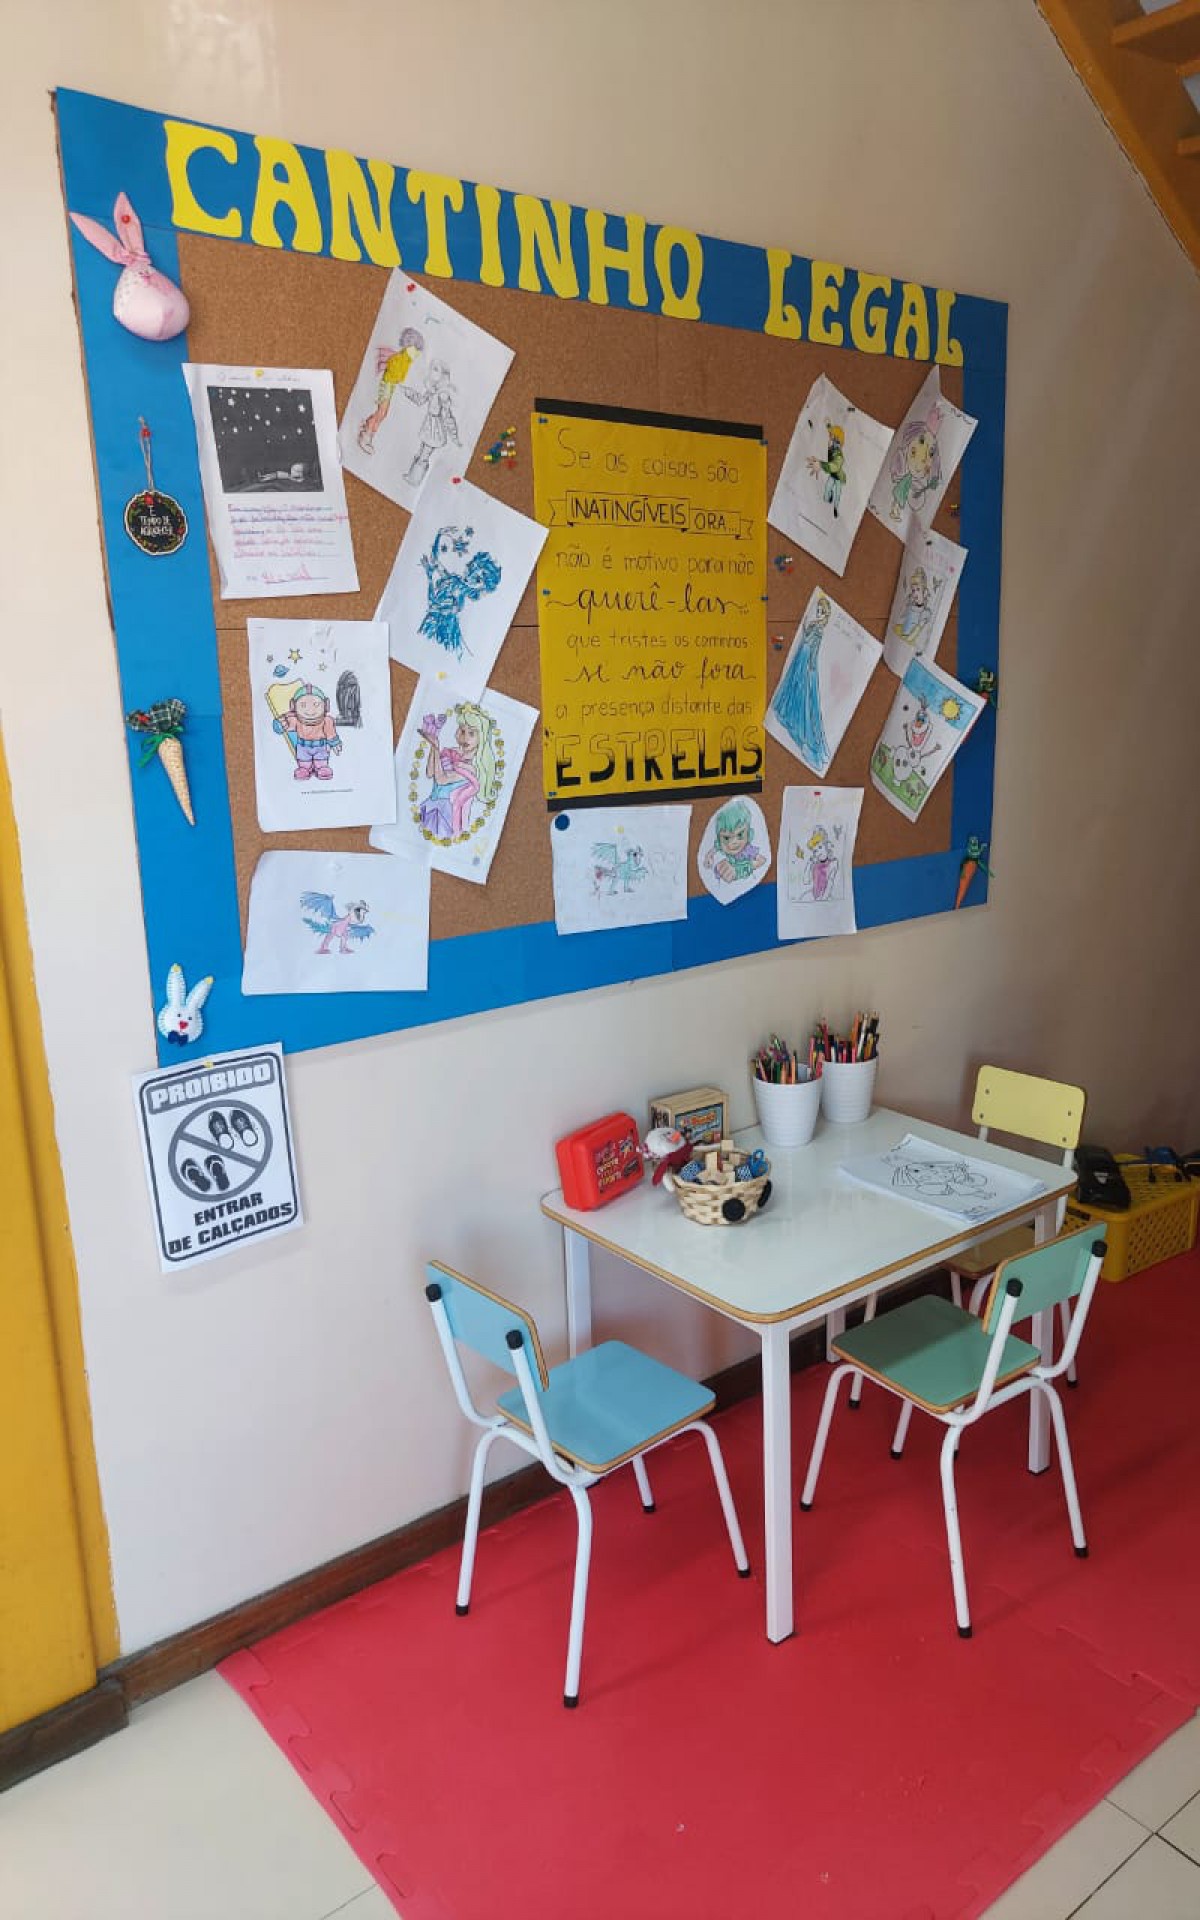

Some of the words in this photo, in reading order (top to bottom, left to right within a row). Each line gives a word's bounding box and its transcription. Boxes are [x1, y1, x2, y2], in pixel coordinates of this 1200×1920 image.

[163, 120, 706, 321] CANTINHO
[763, 249, 966, 367] LEGAL
[557, 427, 592, 469] Se
[605, 451, 628, 474] as
[642, 450, 698, 480] coisas
[706, 459, 740, 484] são
[570, 494, 688, 526] INATINGÍVEIS
[555, 543, 592, 569] não
[602, 546, 613, 570] é
[623, 550, 680, 573] motivo
[688, 556, 725, 580] para
[728, 552, 755, 576] não
[566, 633, 601, 657] que
[609, 627, 668, 648] tristes
[674, 634, 689, 648] os
[621, 659, 685, 681] não
[696, 656, 756, 690] fora
[556, 703, 569, 720] a
[580, 700, 656, 727] presença
[661, 692, 723, 716] distante
[727, 695, 754, 716] das
[554, 725, 762, 787] ESTRELAS
[149, 1063, 272, 1110] PROIBIDO
[193, 1192, 264, 1227] ENTRAR
[167, 1235, 193, 1255] DE
[197, 1202, 293, 1246] CALÇADOS
